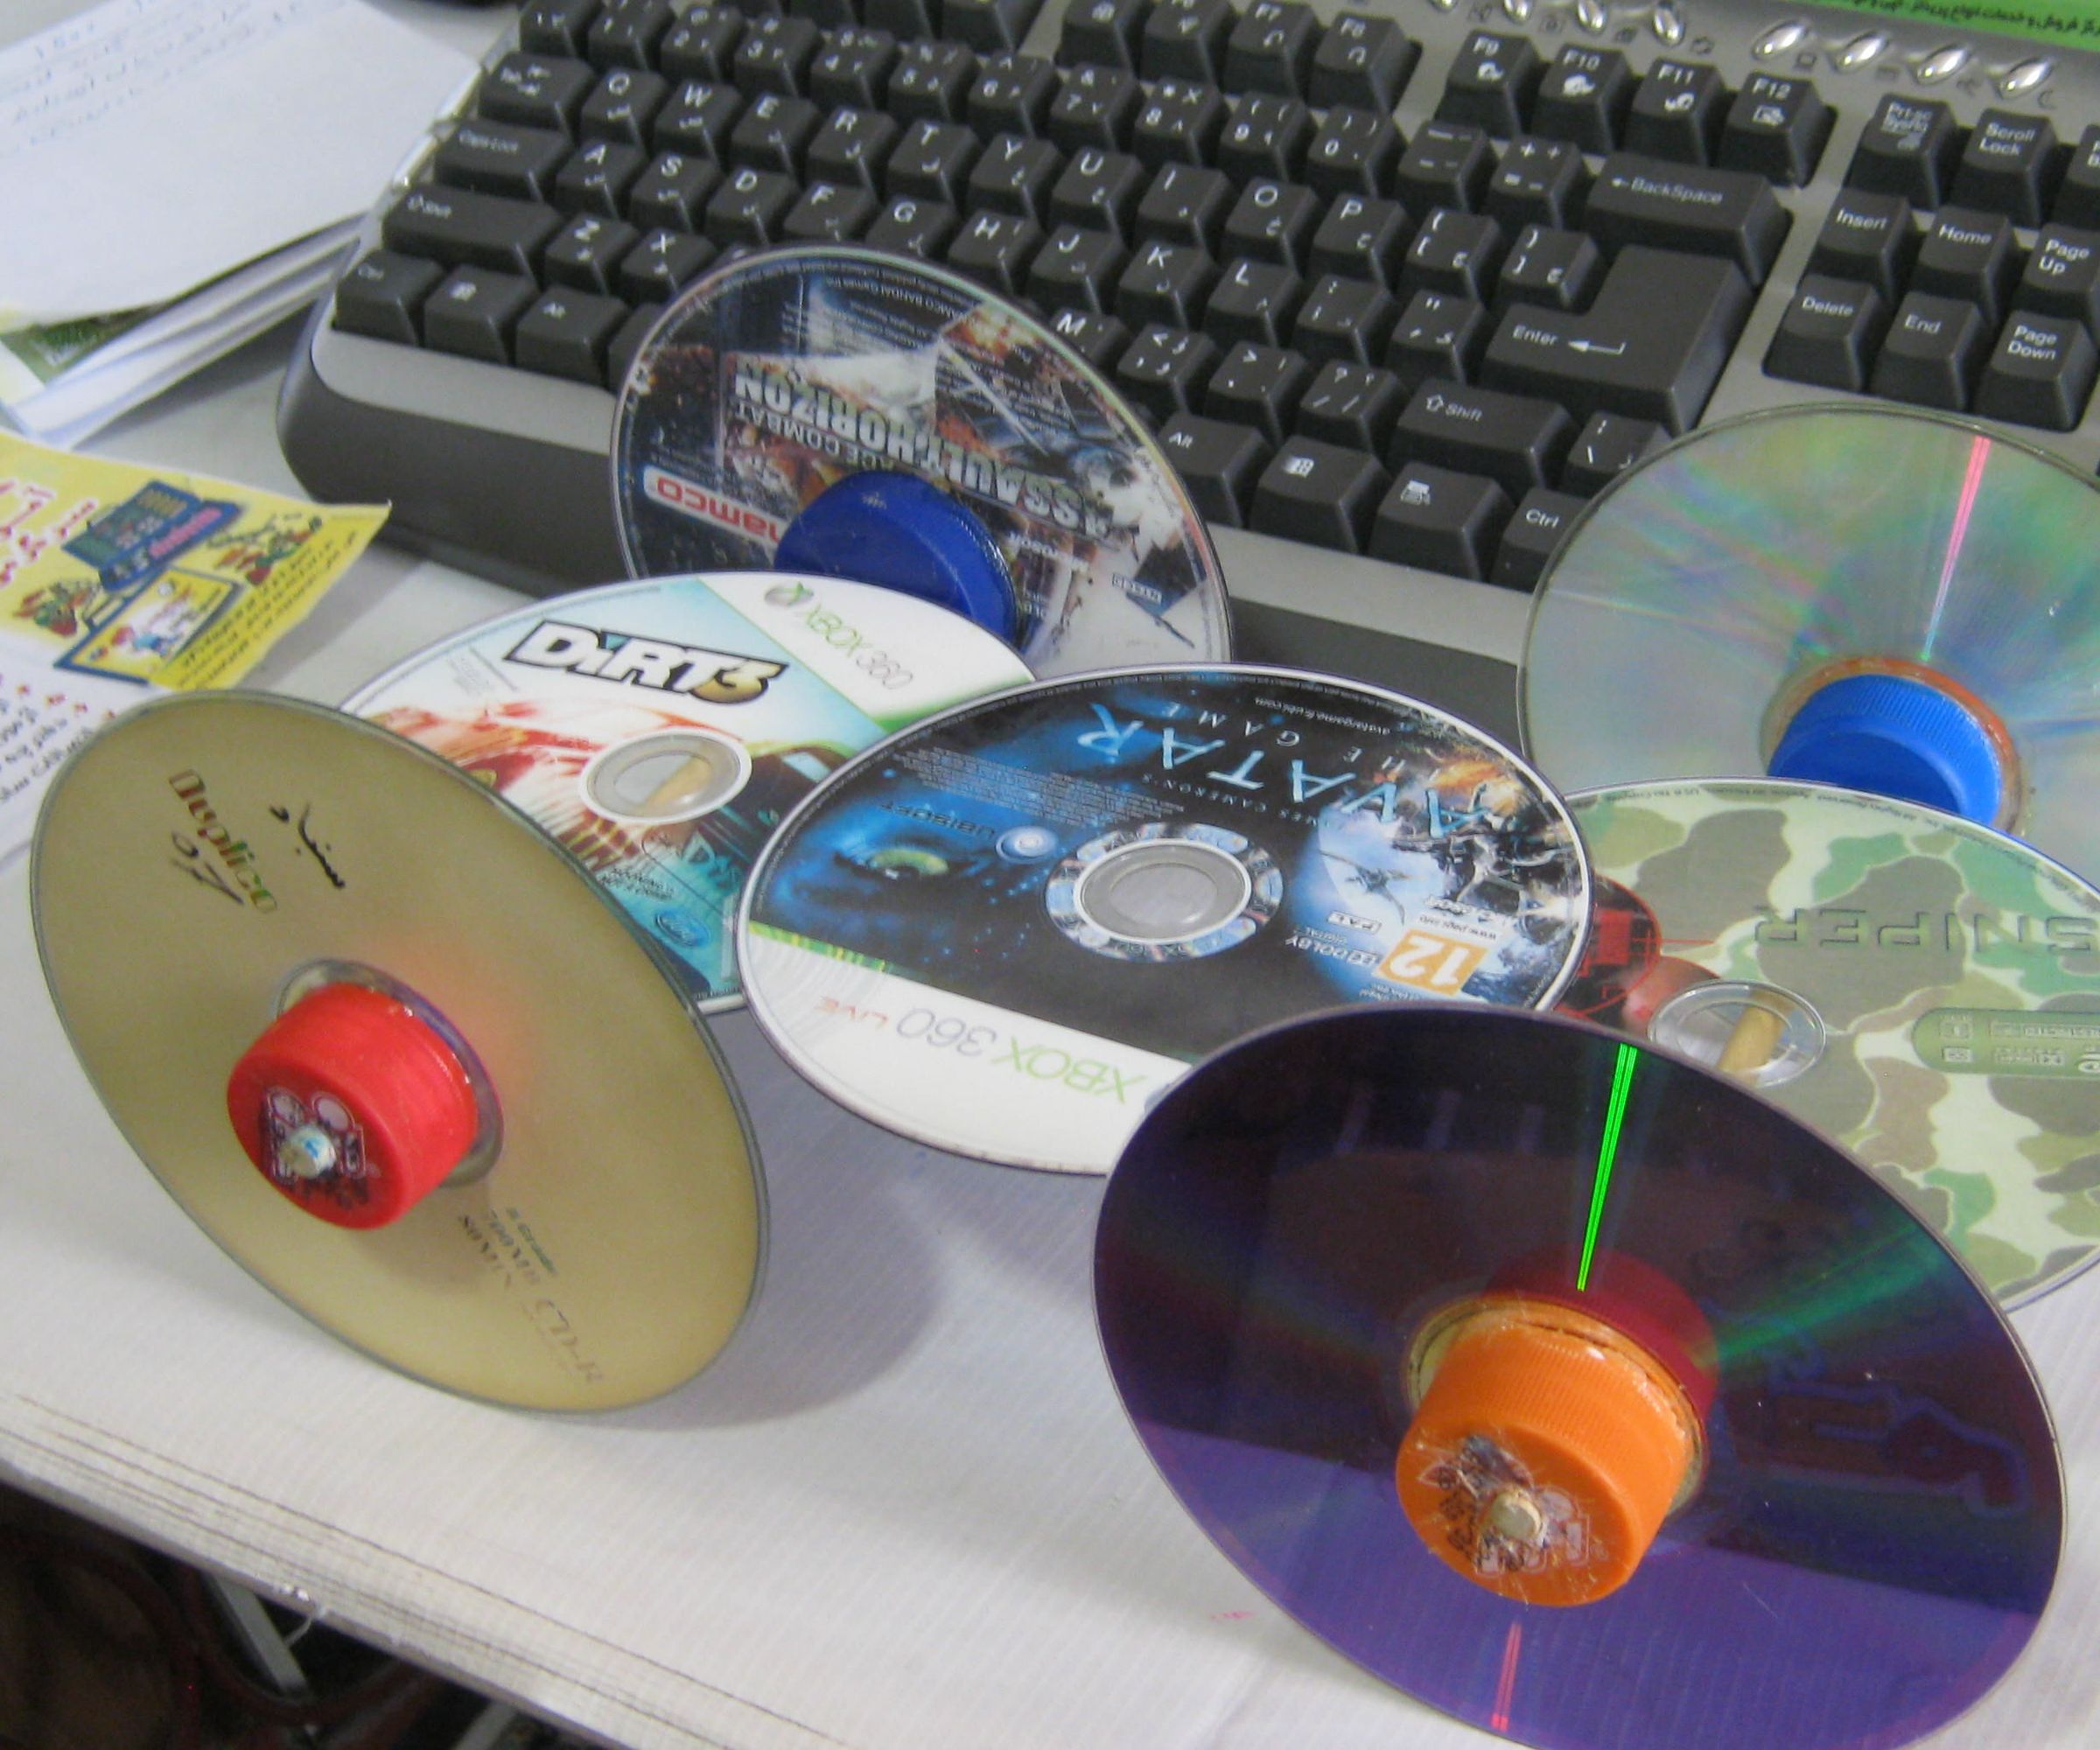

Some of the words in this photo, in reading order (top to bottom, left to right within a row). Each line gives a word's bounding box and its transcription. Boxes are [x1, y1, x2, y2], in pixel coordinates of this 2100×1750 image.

[1563, 49, 1600, 71] F10
[1658, 65, 1694, 85] F11
[1753, 79, 1791, 99] F12
[920, 122, 940, 145] T
[1985, 122, 2036, 143] Scroll
[1005, 139, 1023, 161] Y
[1979, 137, 2022, 157] Lock
[661, 155, 683, 177] S
[1081, 152, 1104, 175] U
[1340, 200, 1363, 220] P
[1836, 208, 1887, 230] Insert
[975, 217, 1002, 239] H
[1938, 223, 1993, 246] Home
[1058, 233, 1081, 254] J
[2045, 238, 2090, 262] Page
[1148, 245, 1172, 268] K
[2038, 256, 2066, 276] Up
[1235, 264, 1250, 286] L
[1802, 296, 1854, 318] Delete
[1056, 312, 1087, 337] M
[1904, 313, 1942, 335] End
[1511, 325, 1559, 346] Enter
[2013, 325, 2058, 346] Page
[2006, 340, 2057, 360] Down
[1445, 402, 1483, 423] Shift
[1525, 508, 1560, 528] Ctrl
[1089, 703, 1491, 840] AVATAR
[880, 802, 996, 837] UBISOFT
[1753, 906, 2098, 954] SNIPER
[1284, 934, 1349, 962] DOLBY
[1389, 935, 1471, 987] 12
[895, 1009, 998, 1059] 360
[990, 1038, 1148, 1104] XBOX
